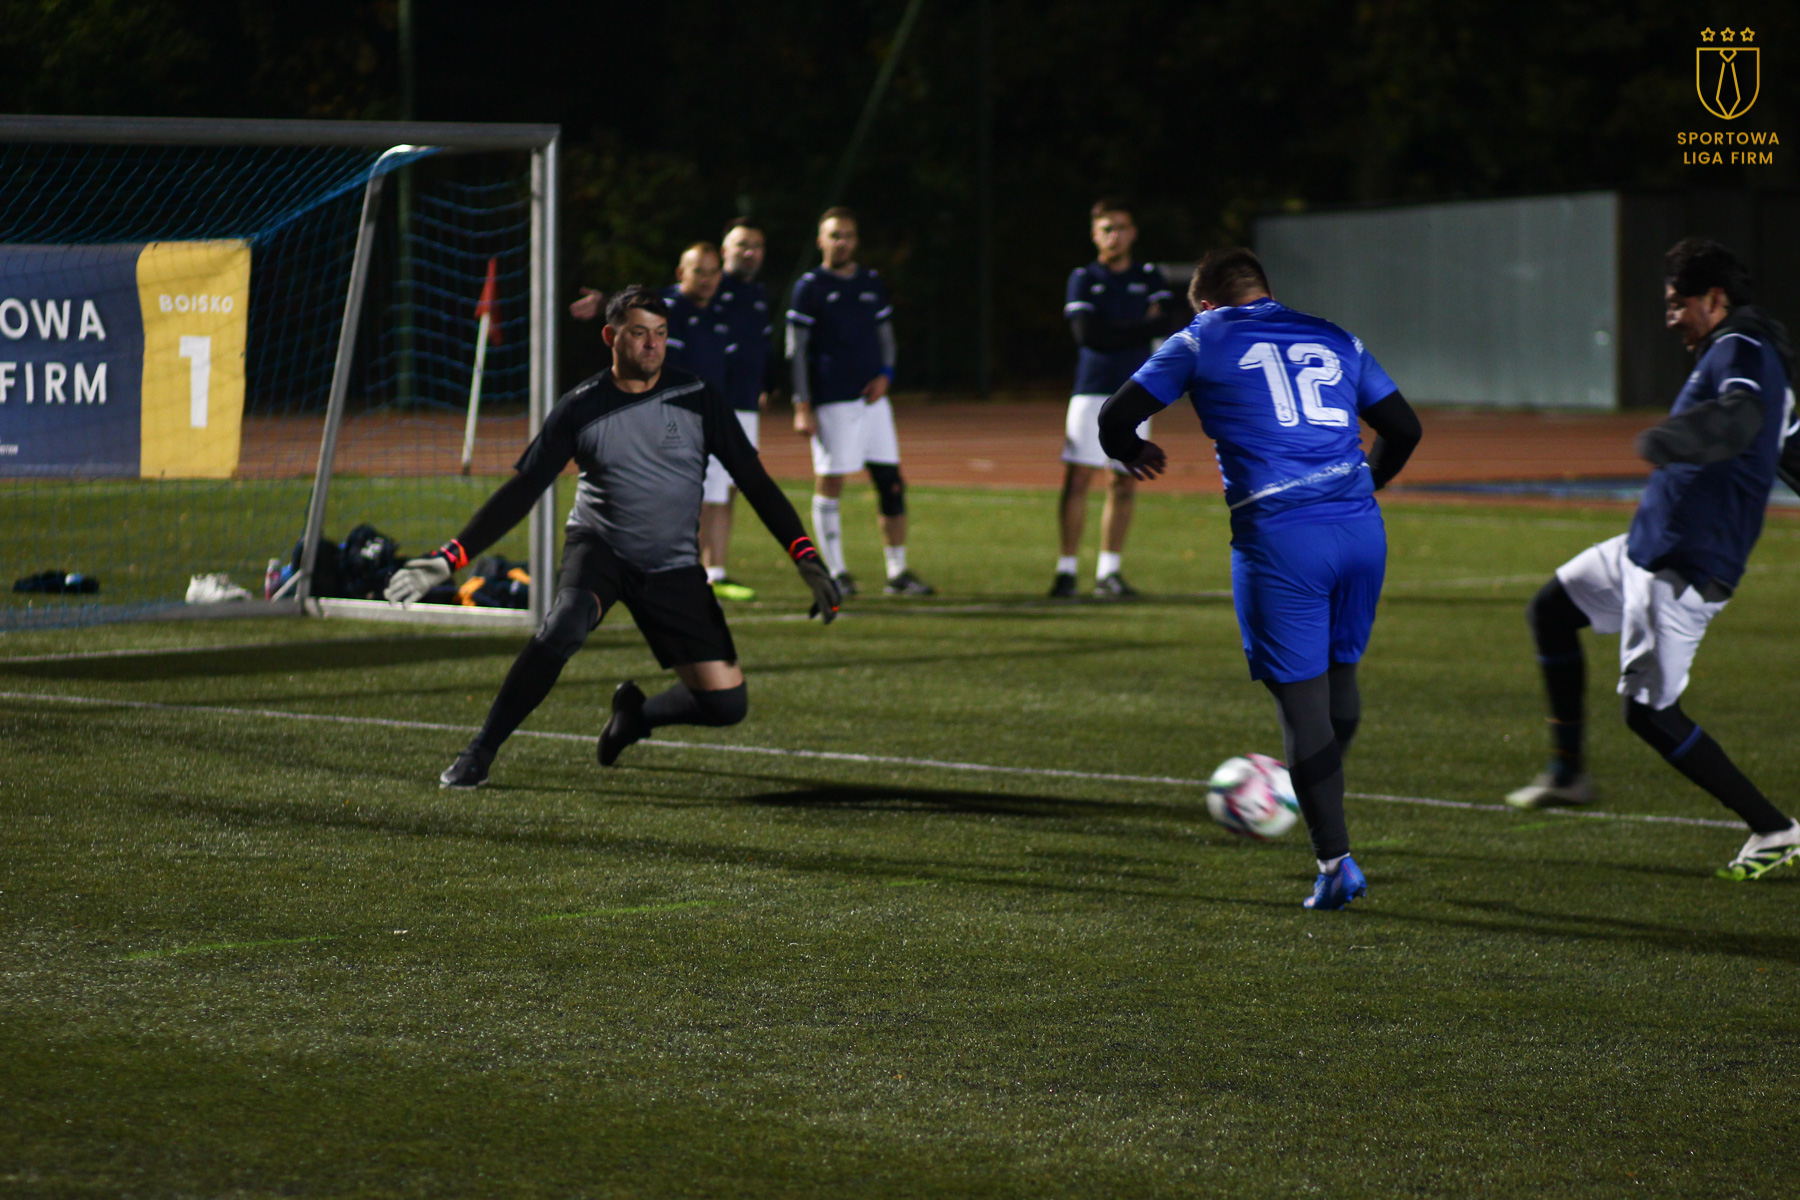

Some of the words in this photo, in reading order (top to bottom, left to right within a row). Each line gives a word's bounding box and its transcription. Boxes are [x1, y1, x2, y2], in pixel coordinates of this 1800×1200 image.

[0, 298, 107, 341] OWA
[158, 294, 234, 314] BOISKO
[0, 361, 107, 405] FIRM
[179, 335, 212, 428] 1
[1237, 341, 1349, 428] 12
